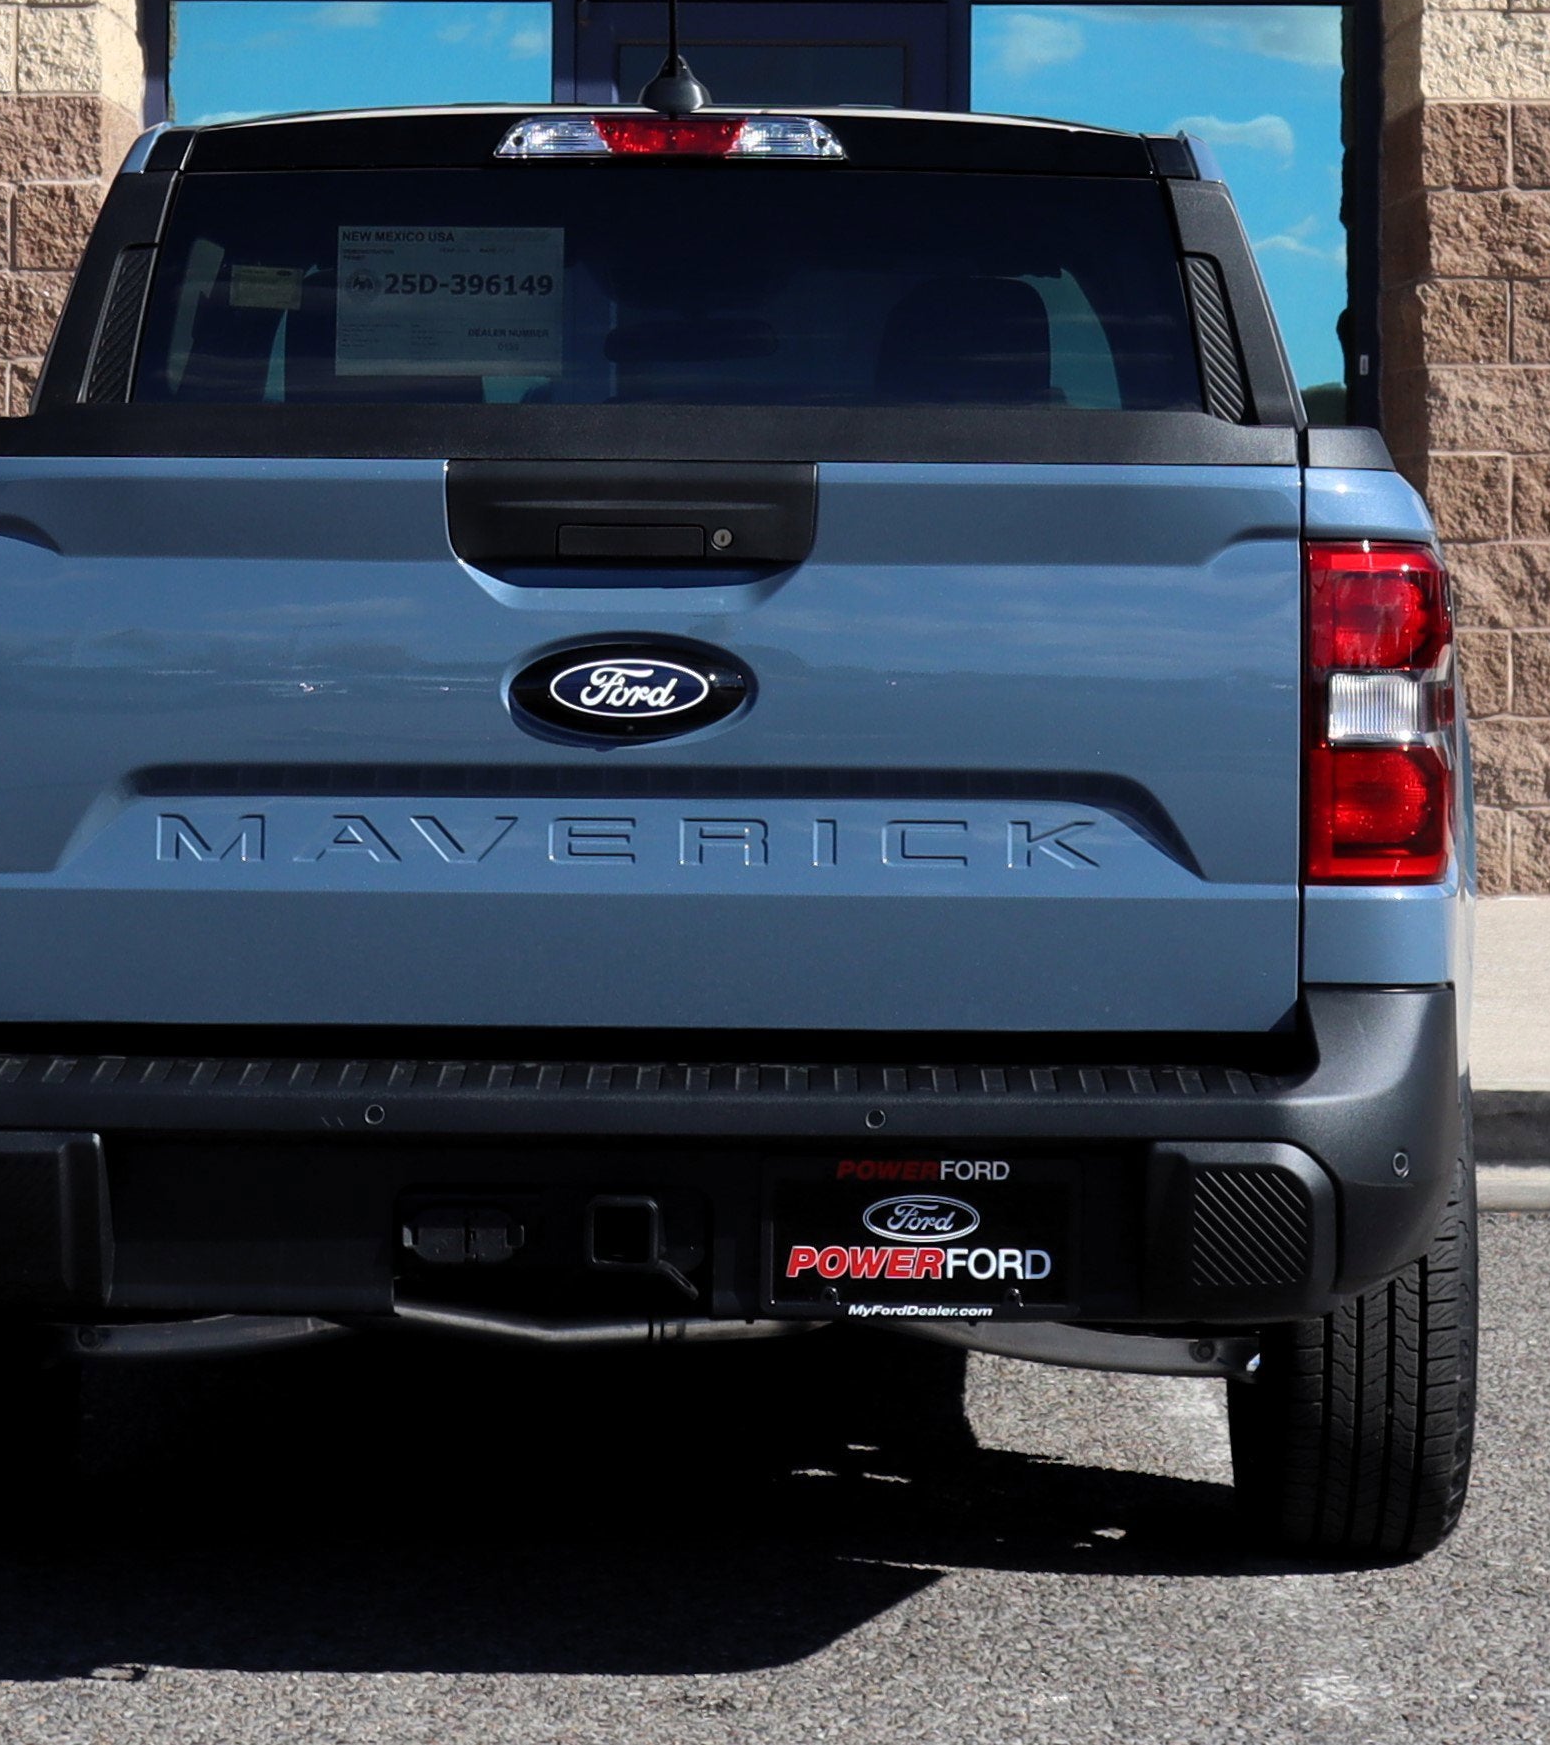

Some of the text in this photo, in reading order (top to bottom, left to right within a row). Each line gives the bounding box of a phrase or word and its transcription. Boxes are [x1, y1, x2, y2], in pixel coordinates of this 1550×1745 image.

[342, 231, 372, 243] NEW
[375, 231, 425, 243] MEXICO
[428, 232, 455, 243] USA
[384, 274, 554, 297] 25D-396149
[581, 667, 676, 709] Ford
[154, 812, 1101, 870] MAVERICK
[886, 1204, 955, 1232] Ford
[785, 1246, 1051, 1280] POWERFORD
[848, 1304, 994, 1318] MyFordDealer.com
